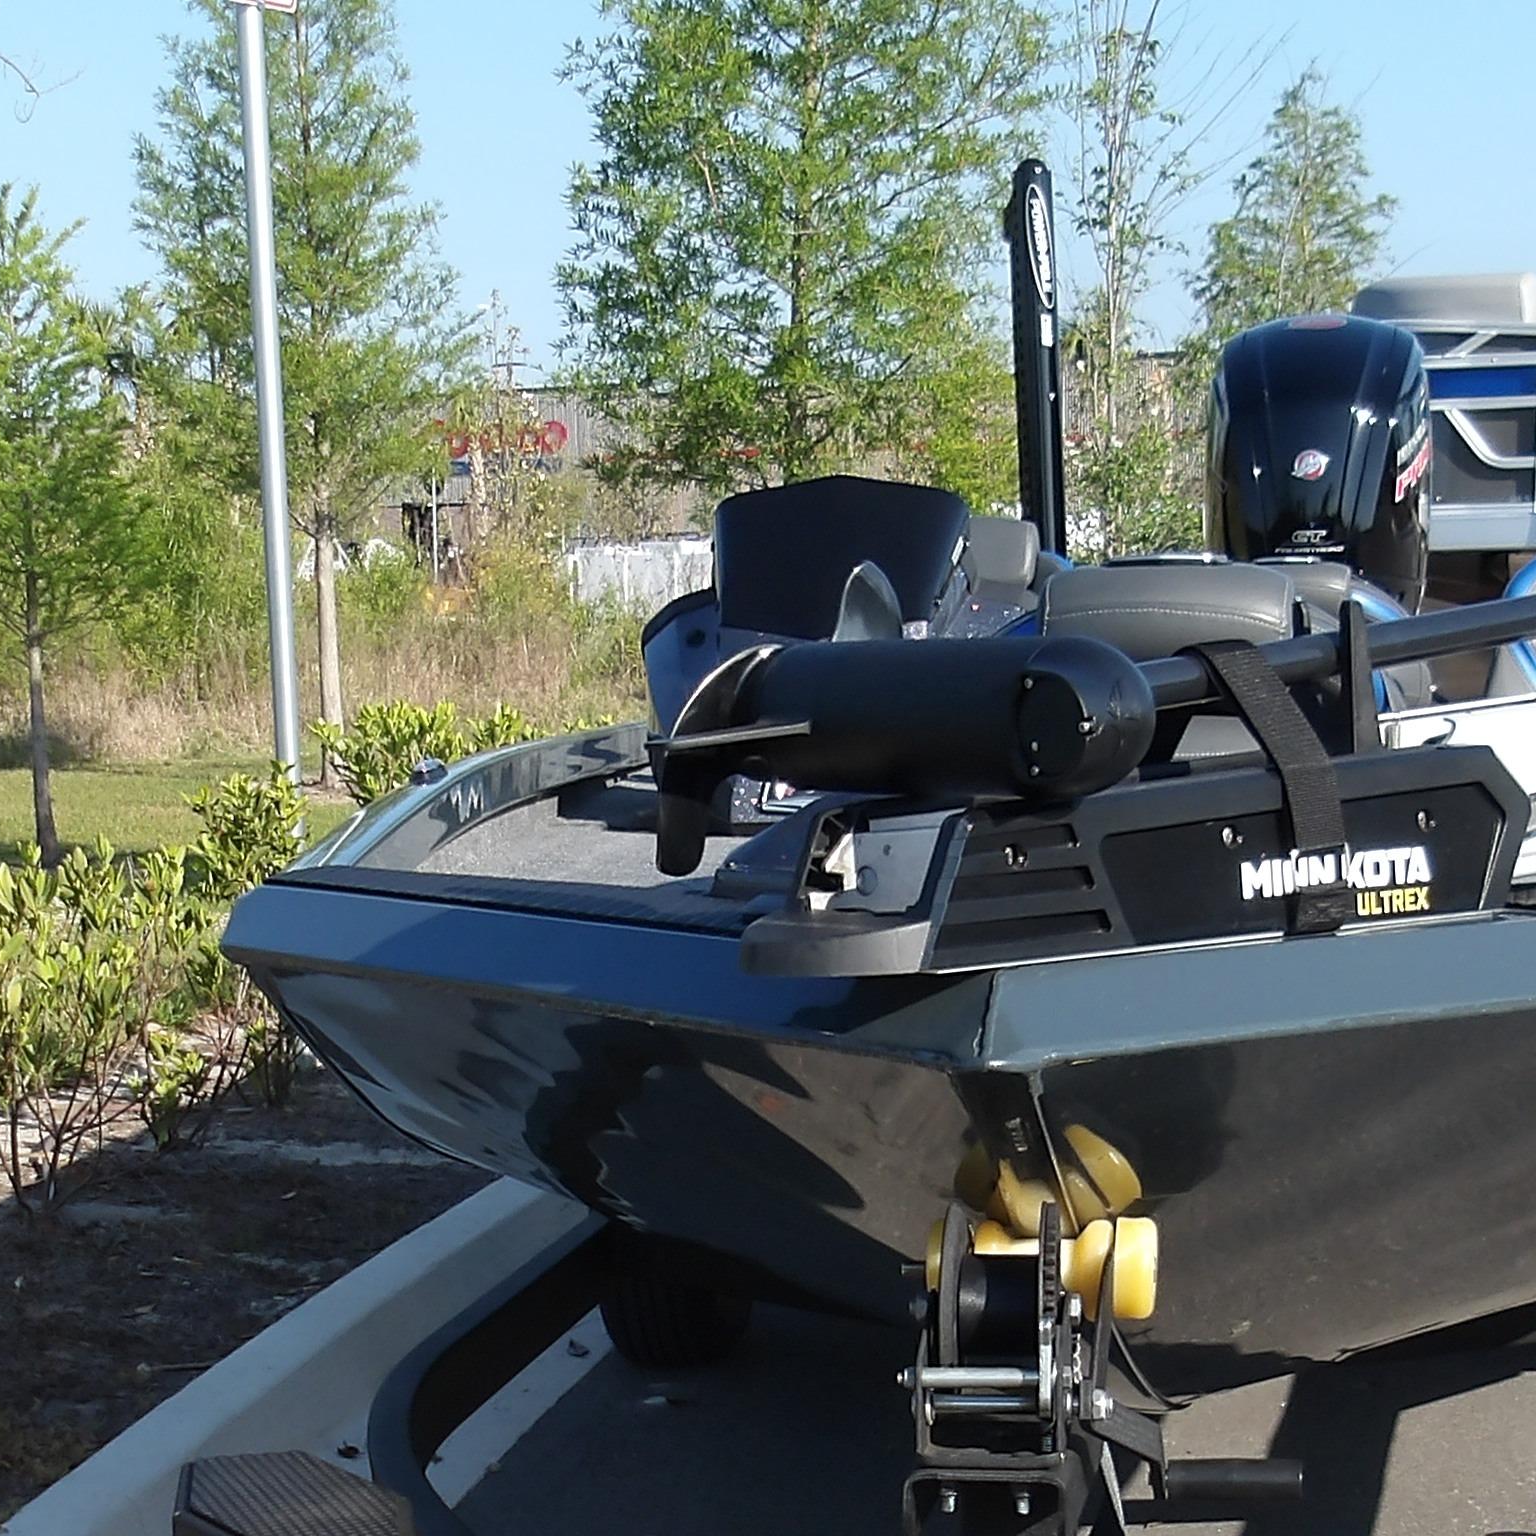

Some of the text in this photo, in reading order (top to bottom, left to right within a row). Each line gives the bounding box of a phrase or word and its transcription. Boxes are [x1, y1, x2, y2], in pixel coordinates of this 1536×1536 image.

[1240, 846, 1432, 900] MINN KOTA
[1356, 886, 1430, 916] ULTREX
